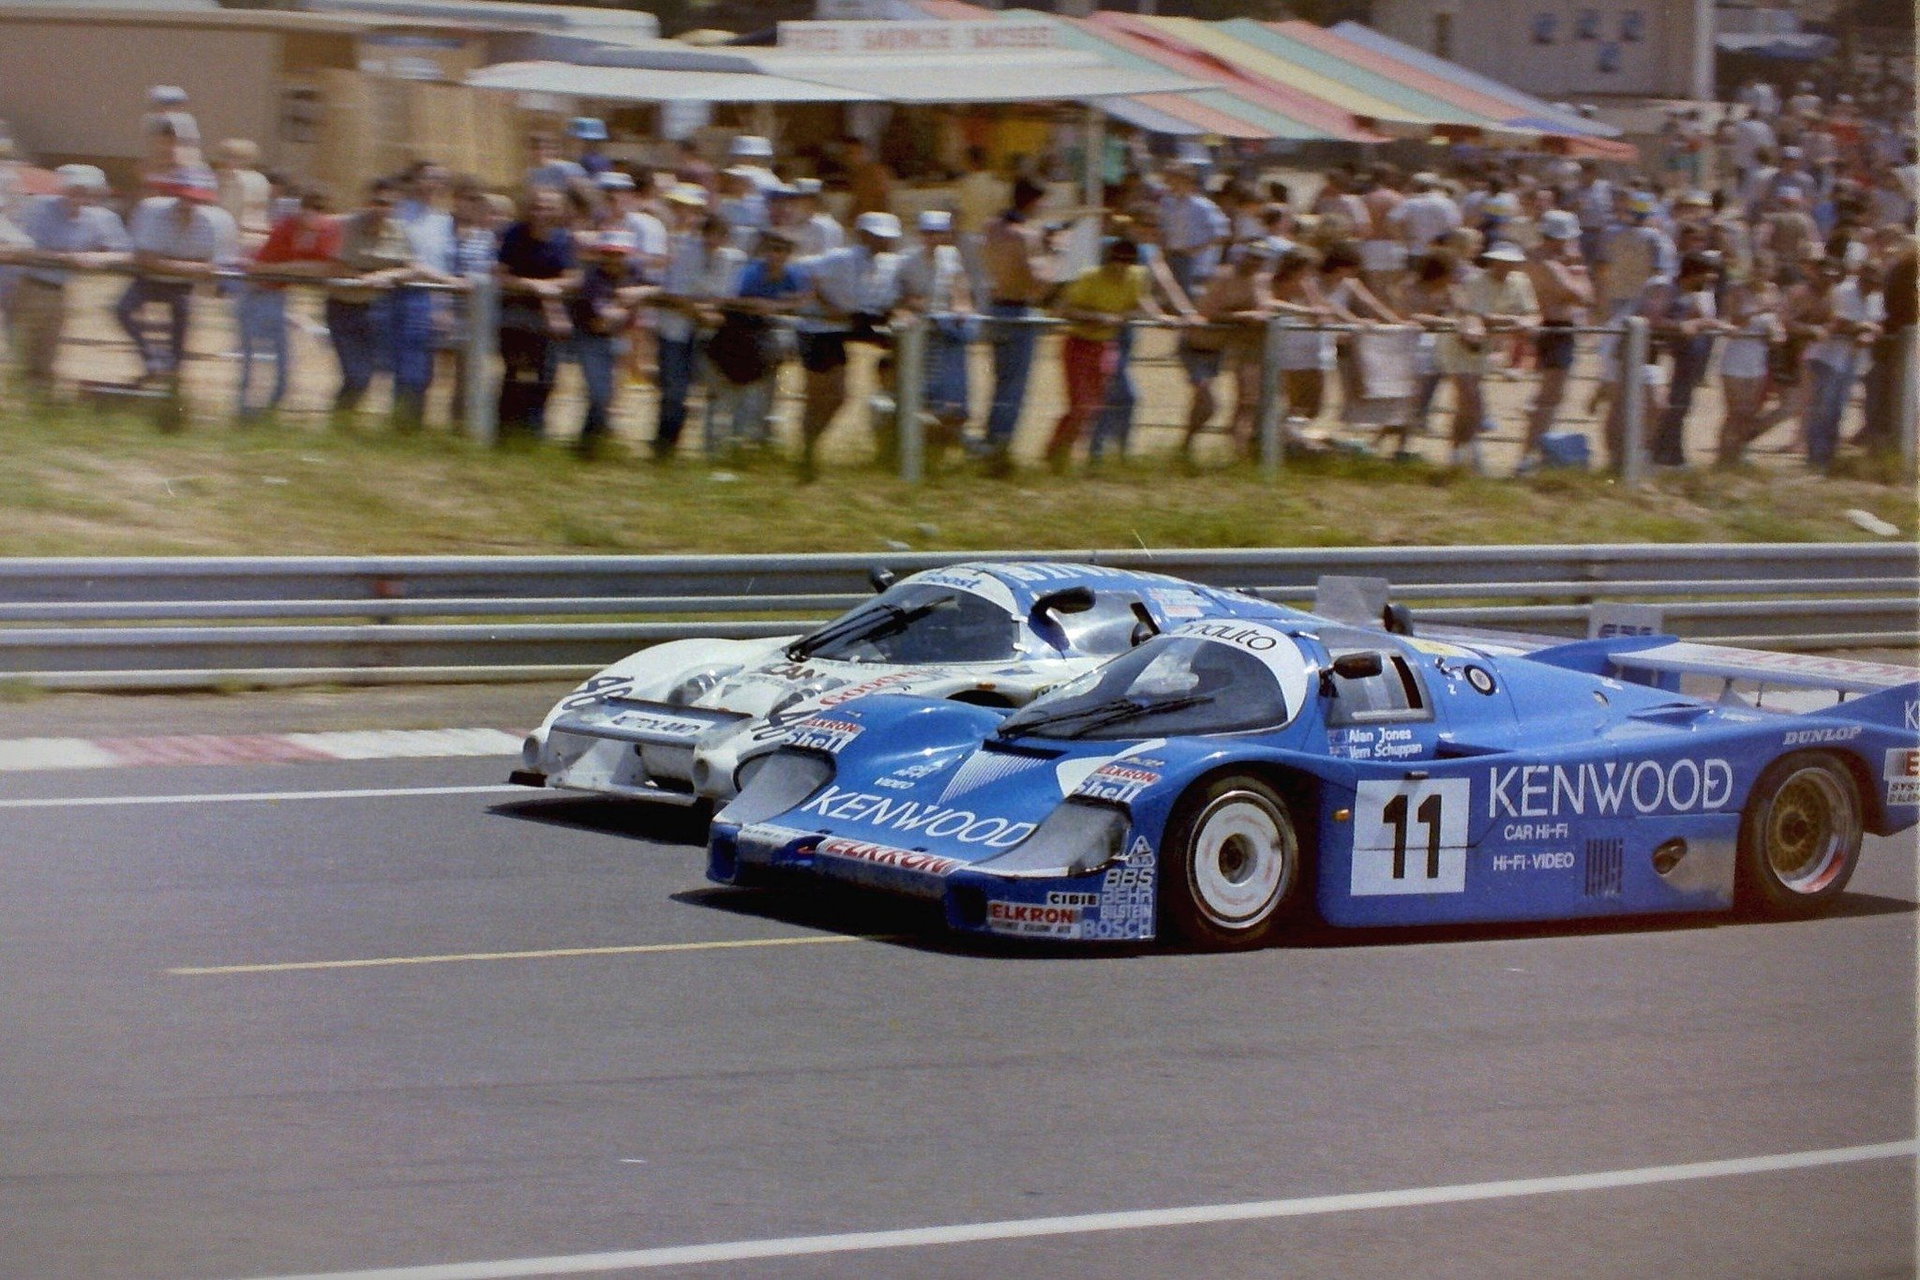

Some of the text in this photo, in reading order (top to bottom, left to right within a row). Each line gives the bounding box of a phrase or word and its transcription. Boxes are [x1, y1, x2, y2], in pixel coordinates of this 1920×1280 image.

[1349, 727, 1412, 744] Alan Jones
[1783, 726, 1863, 746] DUNLOP
[1489, 758, 1734, 818] KENWOOD
[803, 785, 1039, 847] KENWOOD
[1382, 794, 1441, 879] 11
[1504, 822, 1569, 841] CAR Hi-Fi
[827, 841, 953, 874] ELKRON
[1532, 852, 1575, 869] VIDEO
[1105, 868, 1155, 887] BBS
[1050, 893, 1097, 906] CIBIE
[991, 903, 1076, 923] ELKRON
[1082, 918, 1153, 939] BOSCH
